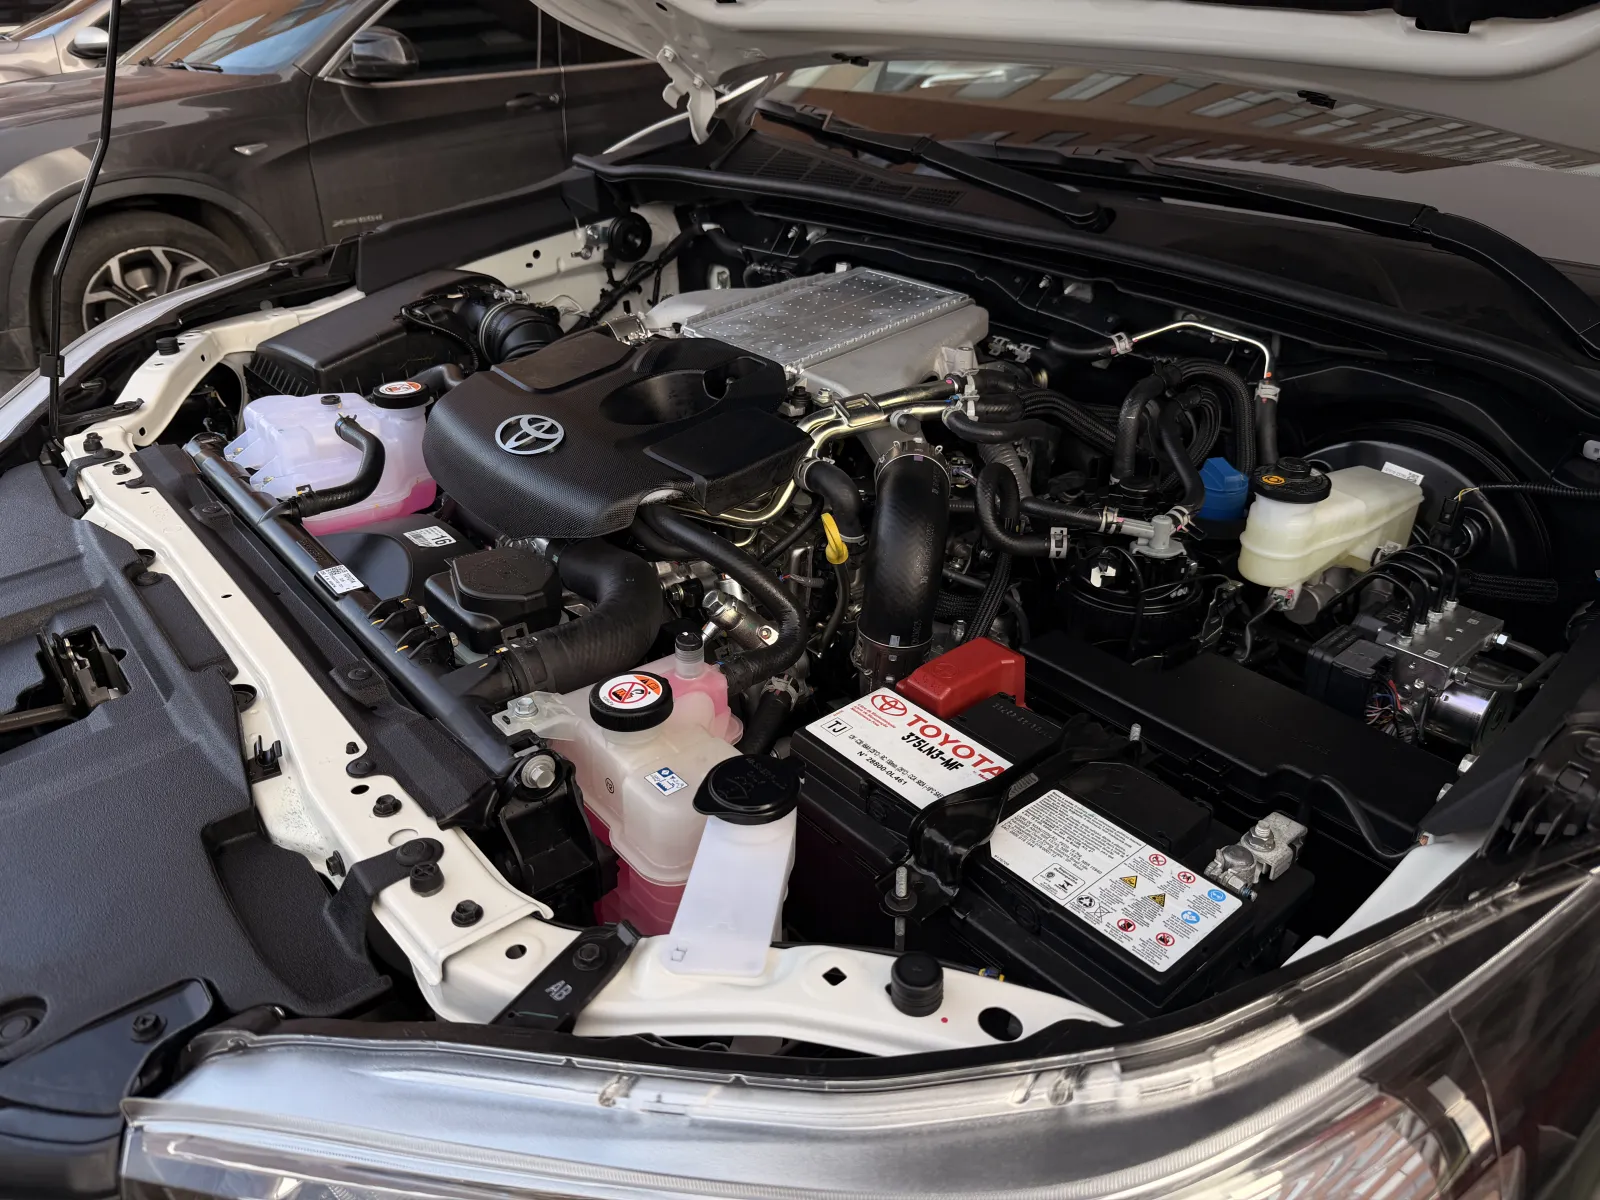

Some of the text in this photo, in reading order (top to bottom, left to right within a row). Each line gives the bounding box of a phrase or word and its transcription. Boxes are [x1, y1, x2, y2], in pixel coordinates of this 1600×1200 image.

[432, 535, 452, 544] 16
[827, 720, 843, 733] TJ
[901, 732, 964, 772] 375LN3-MF
[907, 714, 1004, 779] TOYOTA
[866, 757, 908, 786] 28800-0L461
[545, 980, 572, 1001] AB
